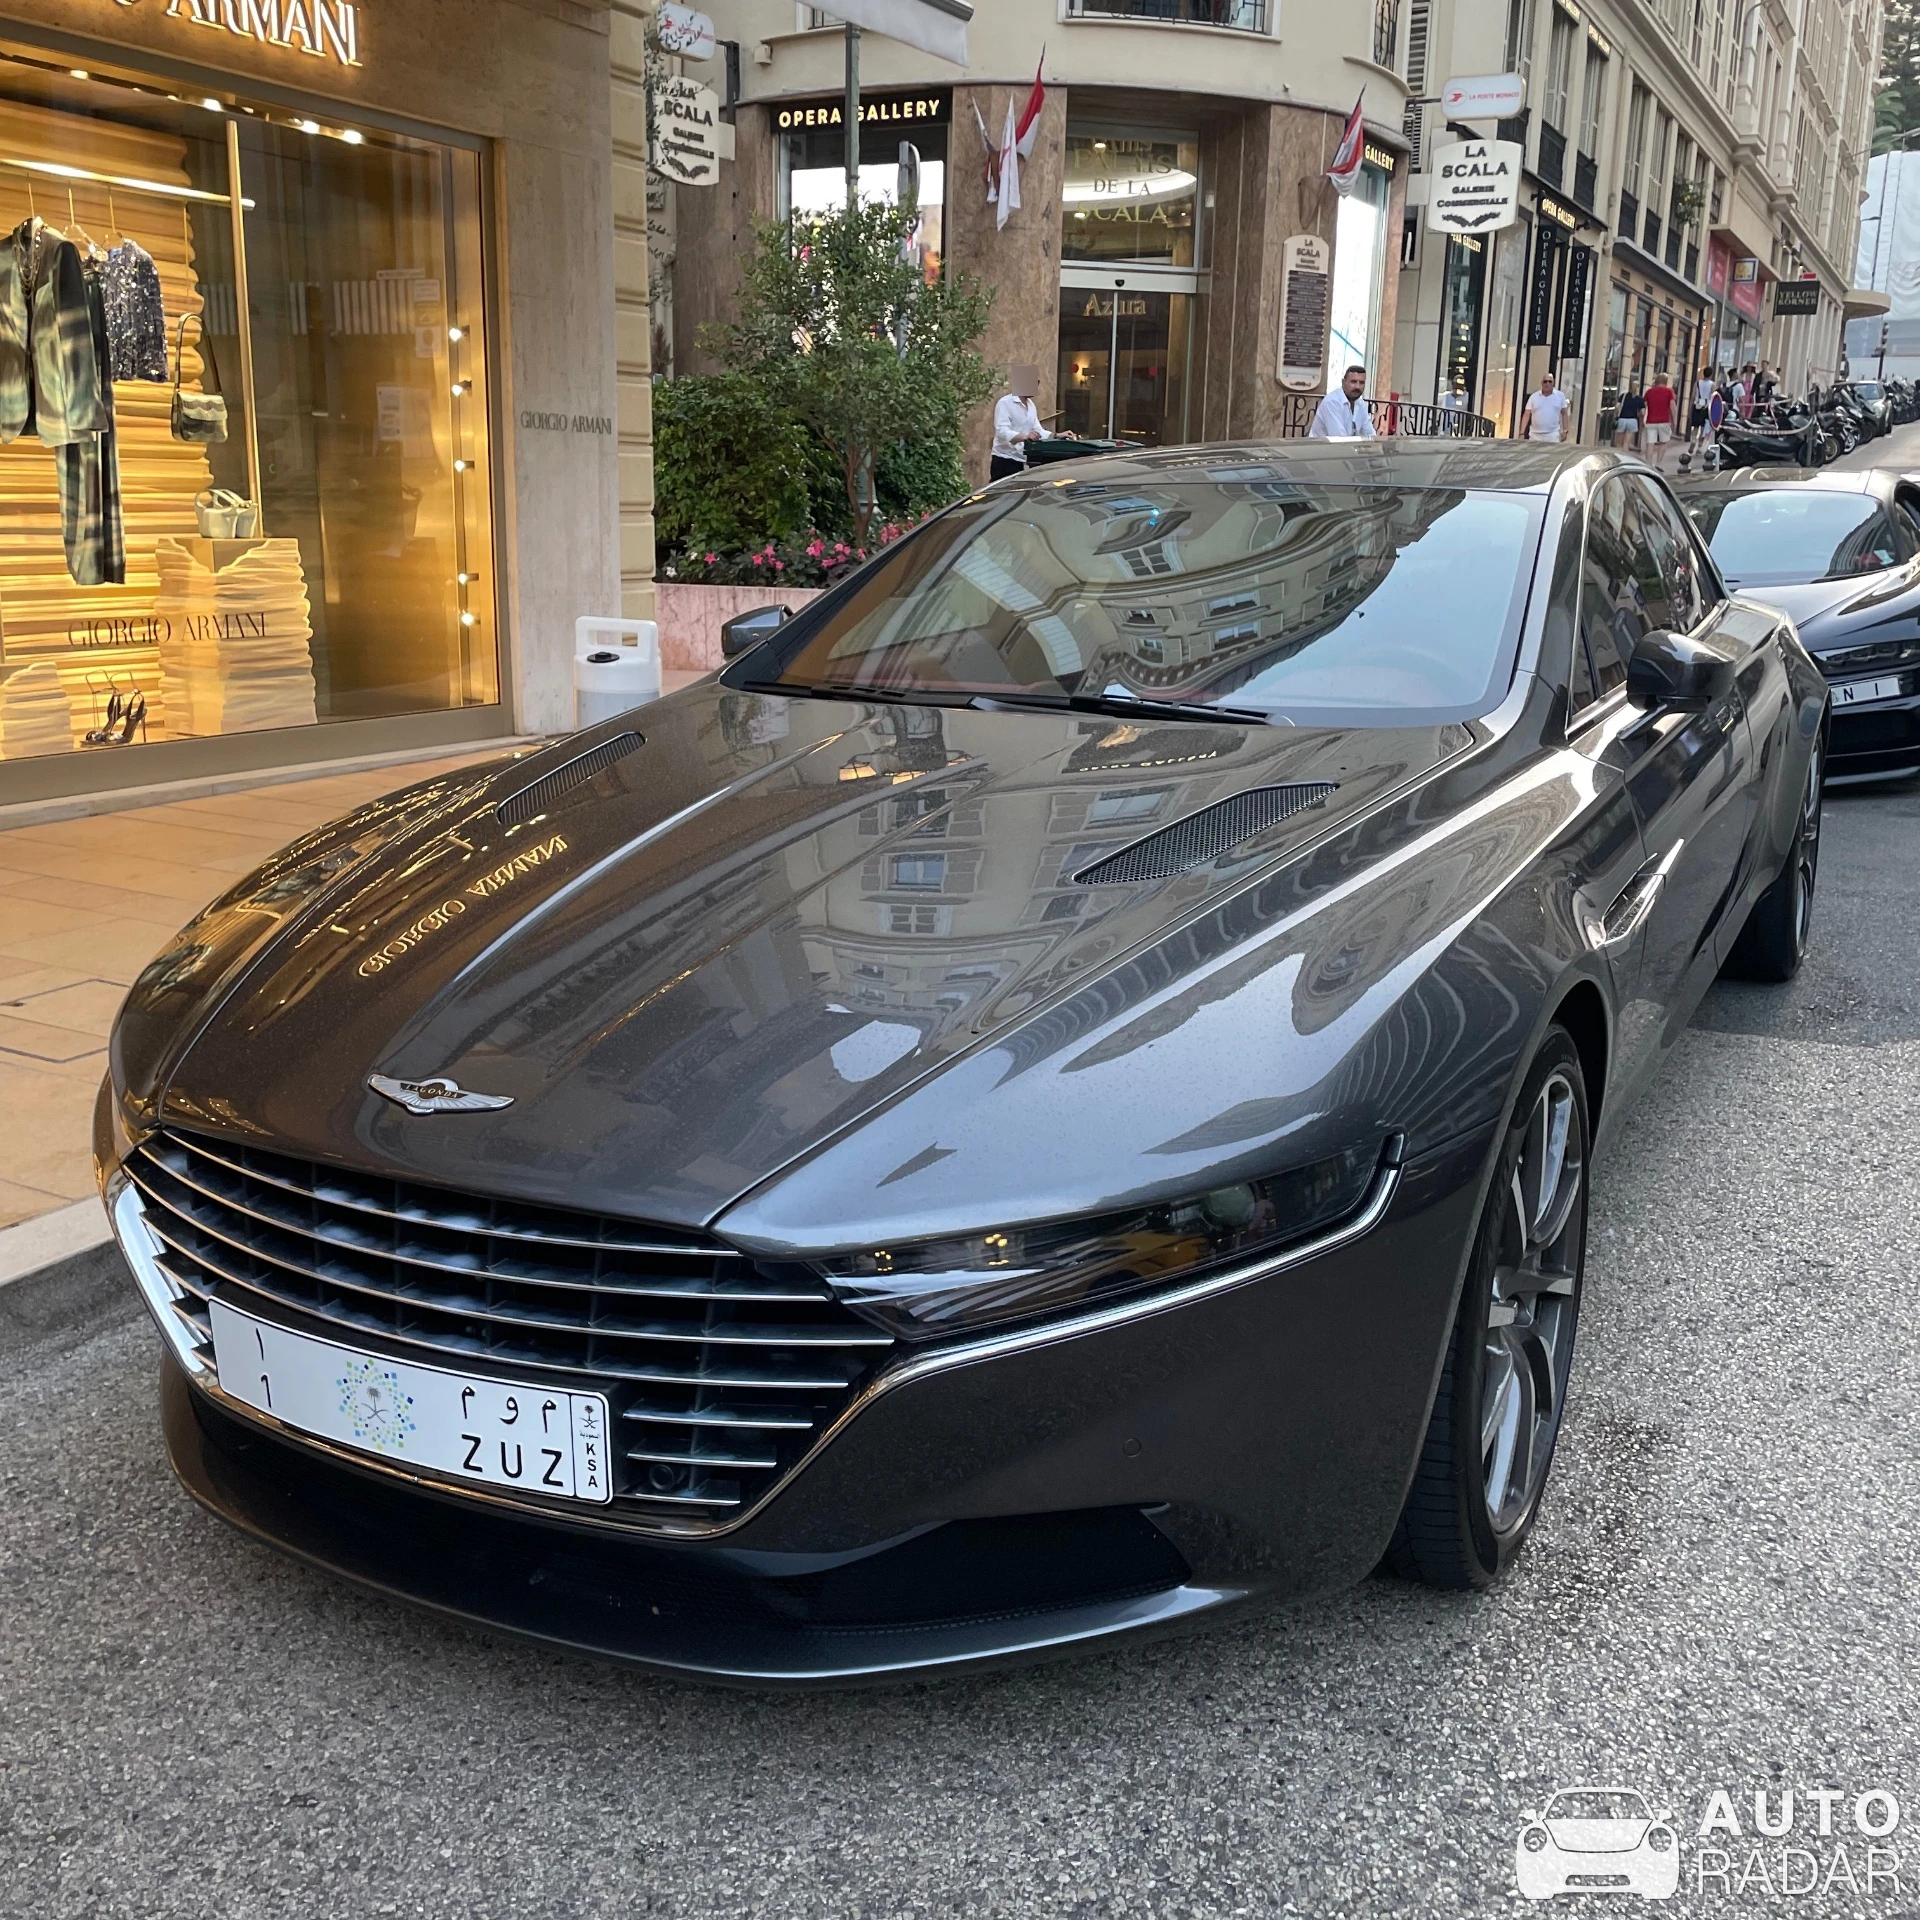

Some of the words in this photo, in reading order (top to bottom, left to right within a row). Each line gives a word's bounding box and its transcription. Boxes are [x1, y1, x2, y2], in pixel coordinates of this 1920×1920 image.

[778, 107, 842, 128] OPERA
[857, 99, 940, 122] GALLERY
[1073, 148, 1173, 174] PALAIS
[1364, 144, 1394, 171] GALLERY
[1465, 145, 1486, 158] LA
[1442, 162, 1508, 178] SCALA
[1093, 178, 1118, 194] DE
[1127, 179, 1151, 196] LA
[1076, 201, 1169, 225] SCALA
[1540, 231, 1551, 276] OPERA
[1573, 251, 1585, 294] OPERA
[1535, 280, 1546, 340] GALLERY
[1568, 298, 1579, 354] GALLERY
[520, 410, 568, 431] GIORGIO
[572, 414, 612, 434] ARMANI
[68, 616, 172, 648] GIORGIO
[181, 611, 266, 641] ARMANI
[1843, 687, 1854, 701] N
